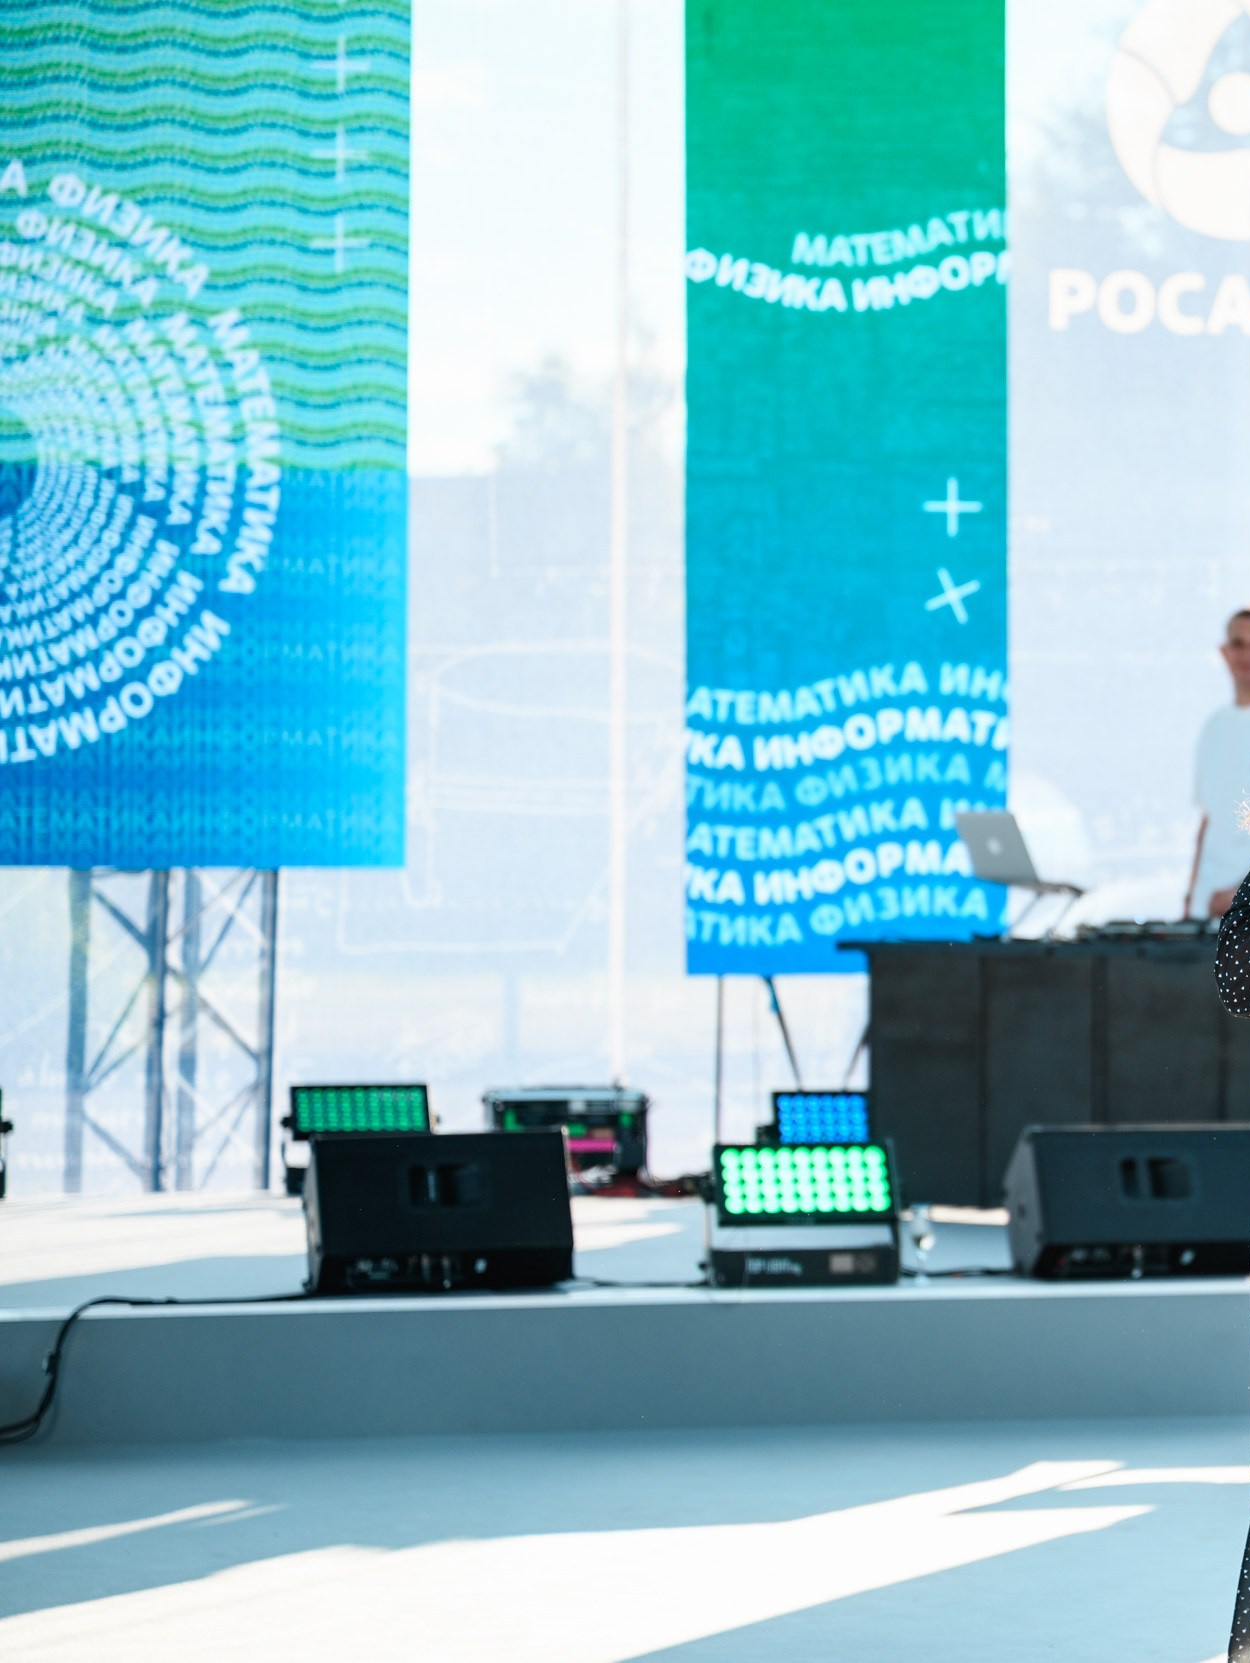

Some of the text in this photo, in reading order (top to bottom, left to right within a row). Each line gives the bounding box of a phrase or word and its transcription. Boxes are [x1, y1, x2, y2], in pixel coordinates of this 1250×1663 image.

[15, 209, 157, 308] ФИЗИКА
[791, 207, 1007, 268] МАТЕМАТИ
[685, 247, 848, 312] ФИЗИКА
[47, 172, 209, 298] ФИЗИКА
[207, 308, 281, 595] МАТЕМАТИКА
[939, 661, 1007, 702] ИН
[795, 752, 972, 807] ФИЗИКА
[808, 885, 990, 937] ФИЗИКА
